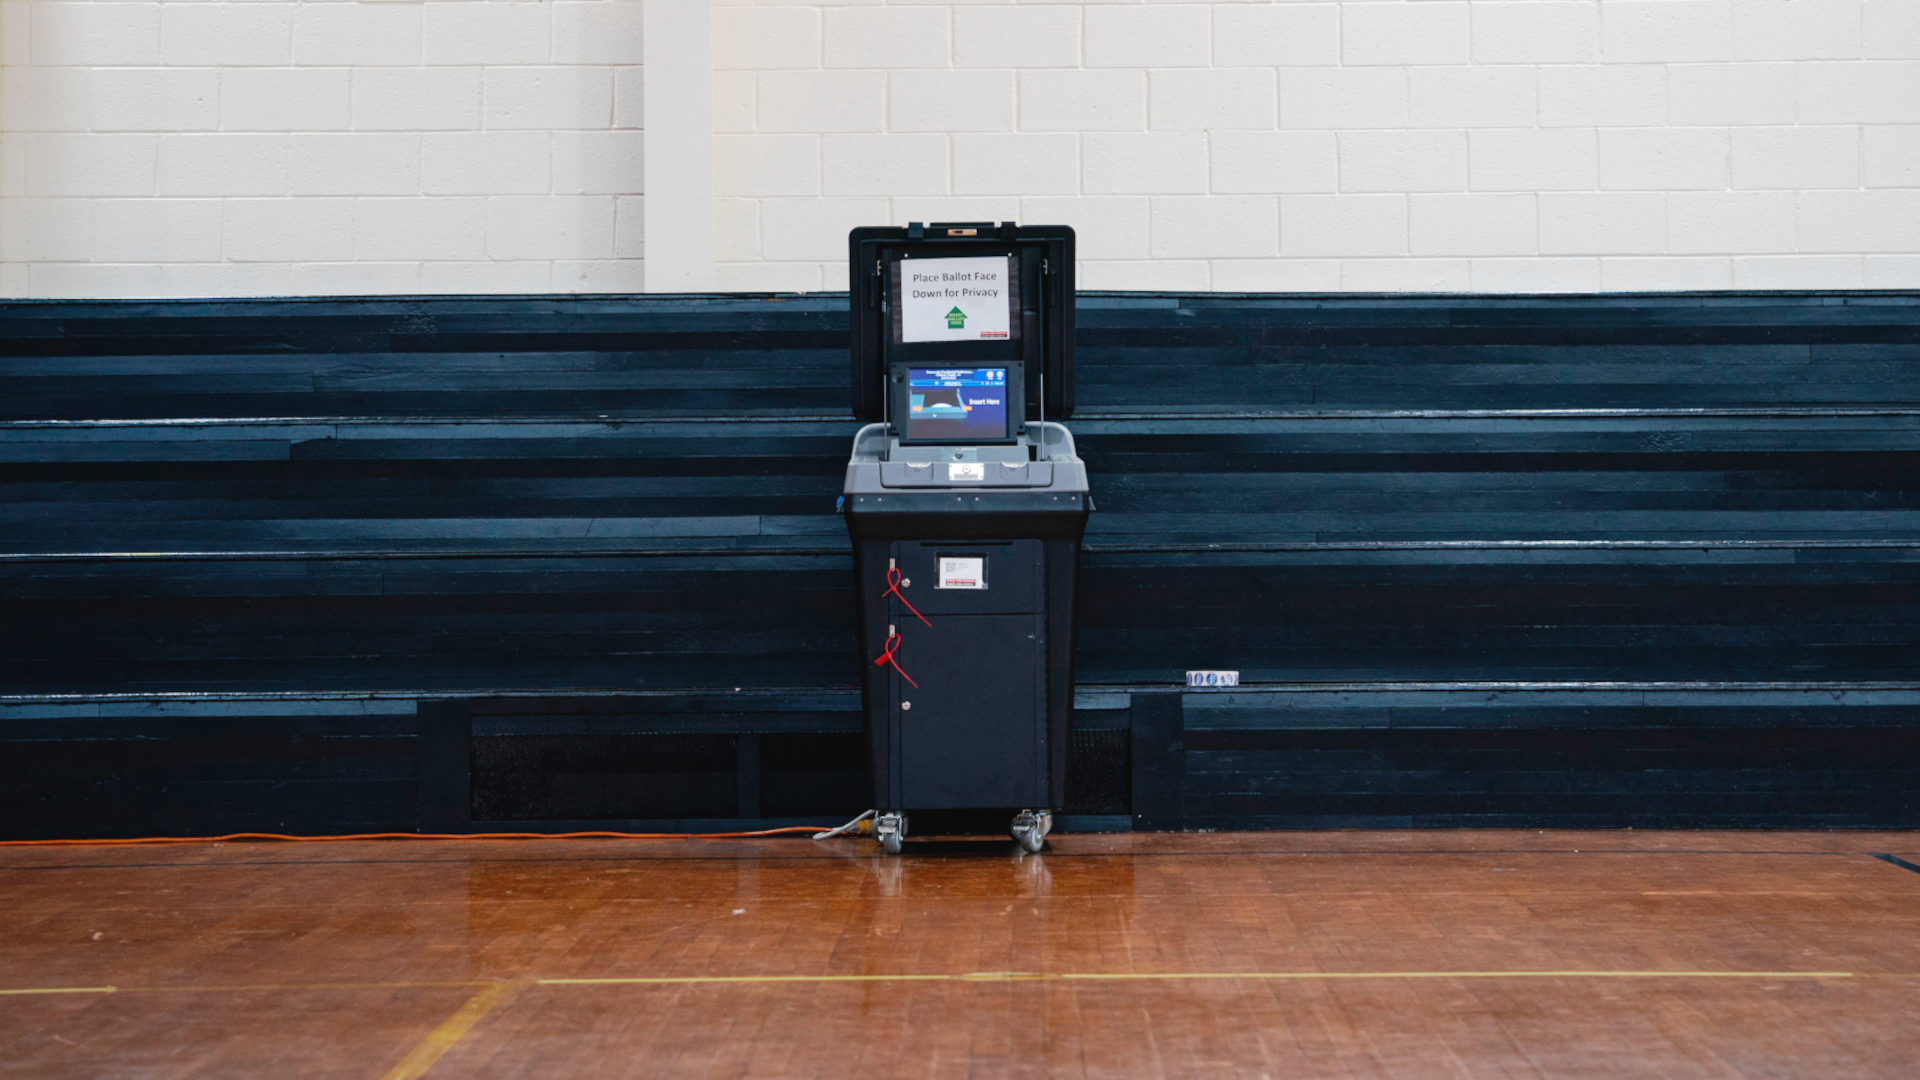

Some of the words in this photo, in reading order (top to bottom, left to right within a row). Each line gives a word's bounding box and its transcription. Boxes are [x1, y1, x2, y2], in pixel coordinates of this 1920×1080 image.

[913, 273, 940, 282] Place
[942, 272, 971, 281] Ballot
[974, 272, 997, 281] Face
[912, 290, 942, 298] Down
[945, 288, 959, 297] for
[962, 288, 998, 298] Privacy
